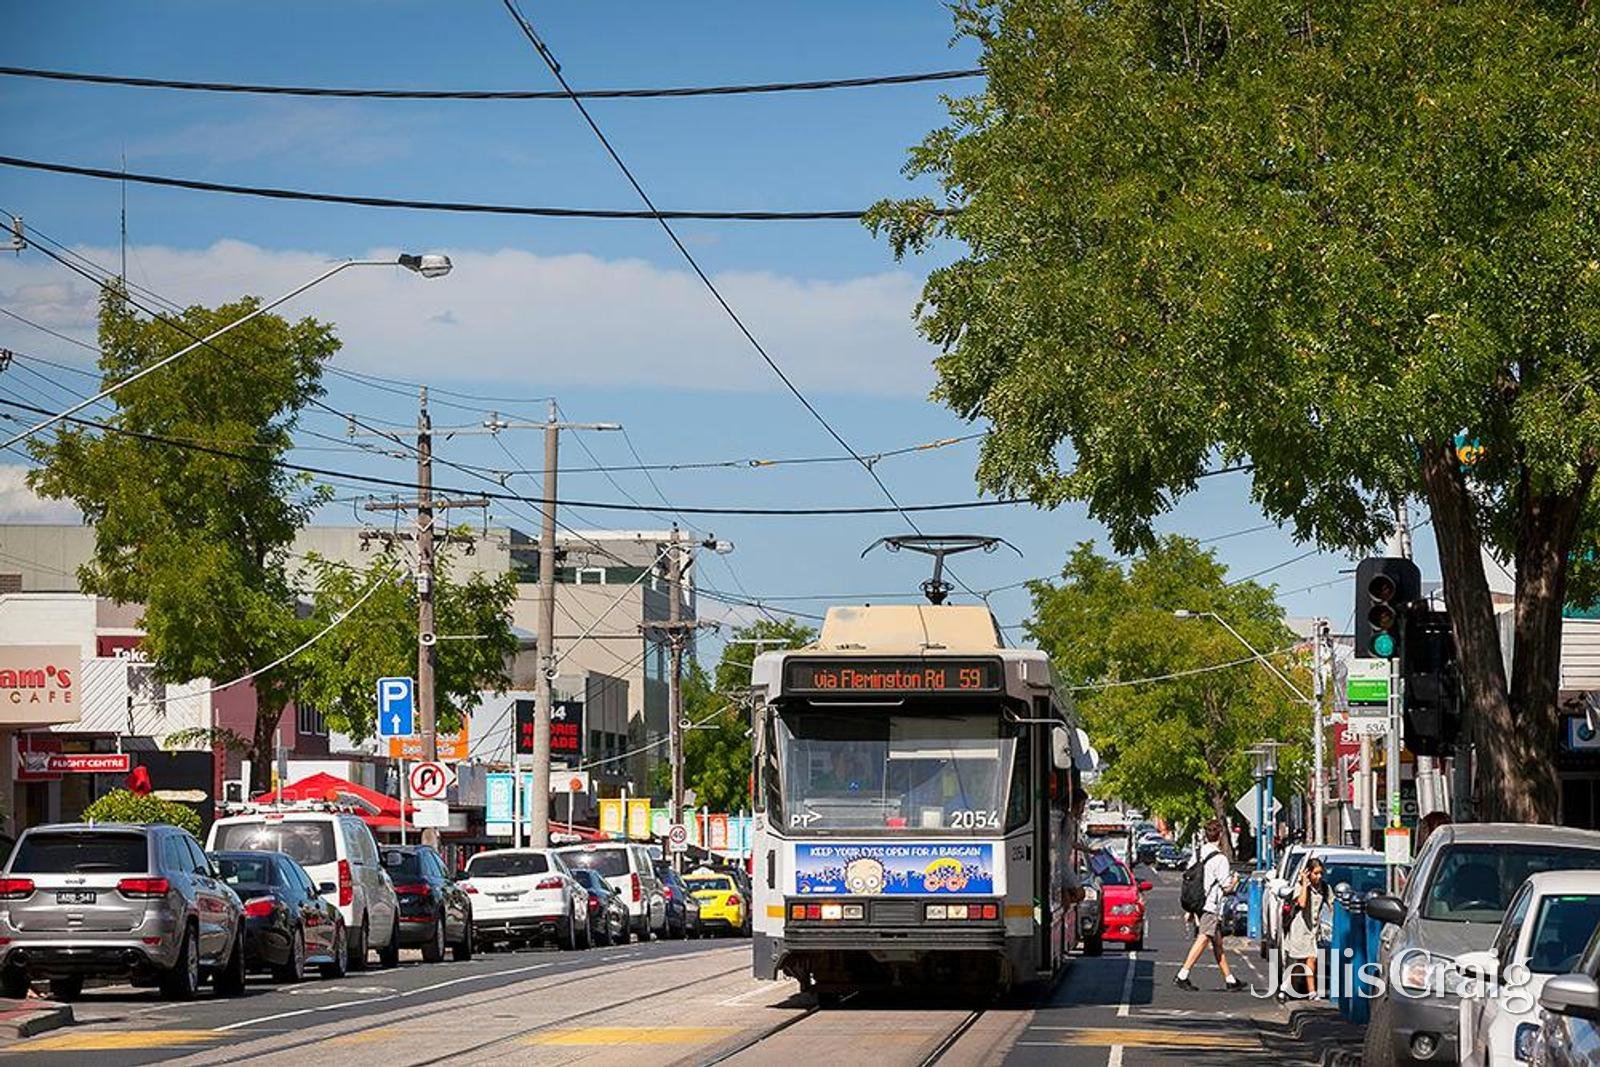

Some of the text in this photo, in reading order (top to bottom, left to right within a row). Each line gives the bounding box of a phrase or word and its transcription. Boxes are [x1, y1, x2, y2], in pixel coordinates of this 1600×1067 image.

[814, 668, 982, 689] via Flemington Rd 59
[10, 691, 72, 704] CAFE
[382, 681, 408, 713] P
[53, 759, 125, 768] FLIGHT CENTRE
[951, 811, 1000, 829] 2054
[673, 829, 684, 839] 40
[810, 847, 981, 857] KEEP YOUR EYES OPEN FOR A BARGAIN
